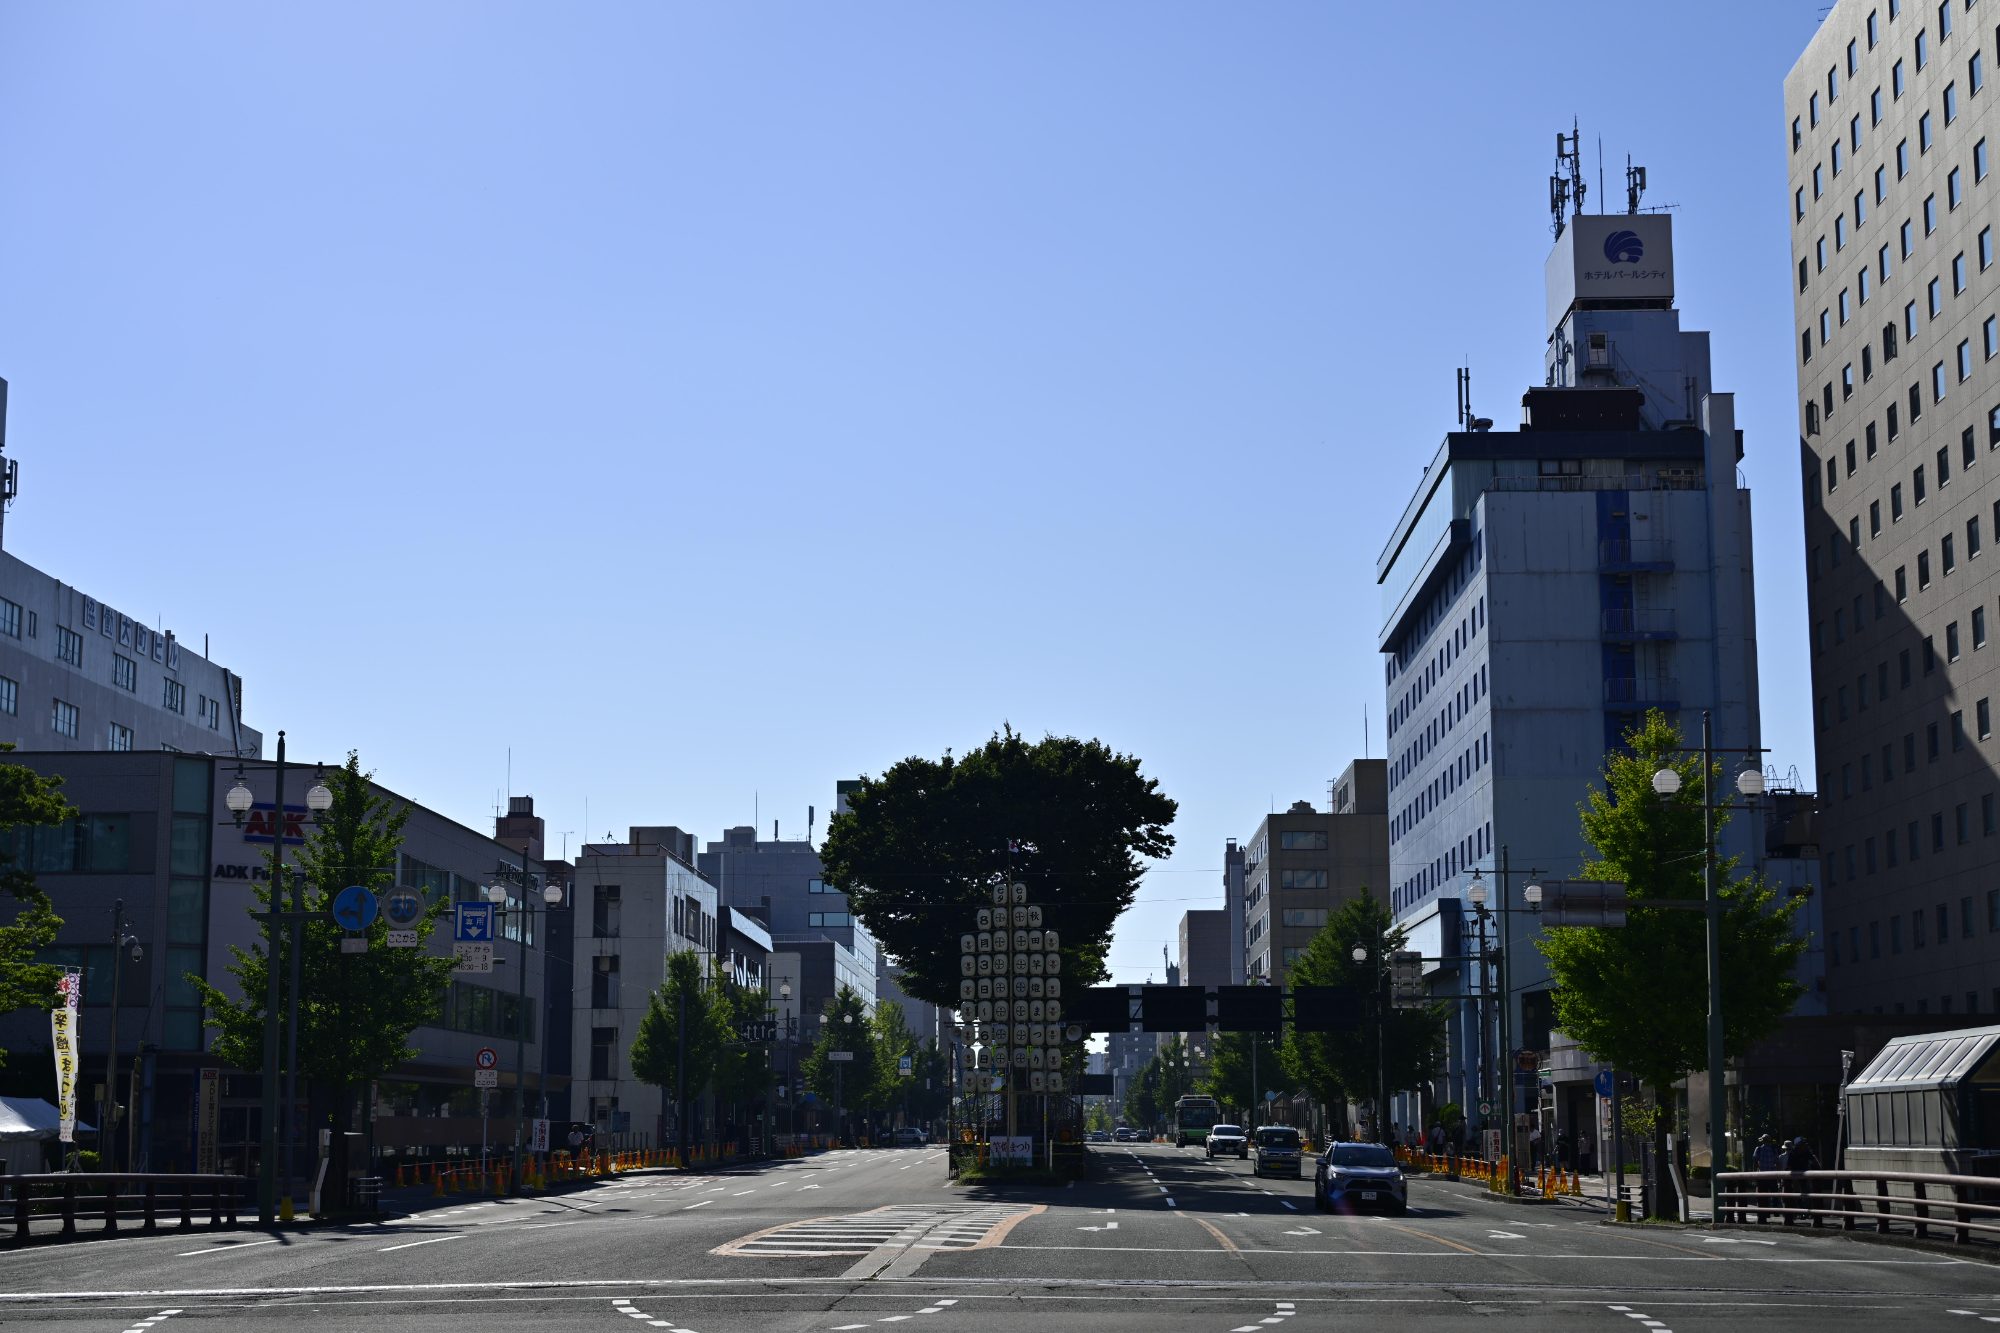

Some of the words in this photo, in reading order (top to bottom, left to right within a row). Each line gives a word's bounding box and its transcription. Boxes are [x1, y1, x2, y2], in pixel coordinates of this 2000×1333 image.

[1584, 270, 1666, 281] ホテルパールシティ
[87, 600, 178, 668] 協働大町ビル
[245, 811, 307, 837] ADK
[214, 864, 249, 879] ADK
[391, 898, 417, 916] 50
[388, 933, 416, 943] ここから
[456, 945, 491, 953] ここから
